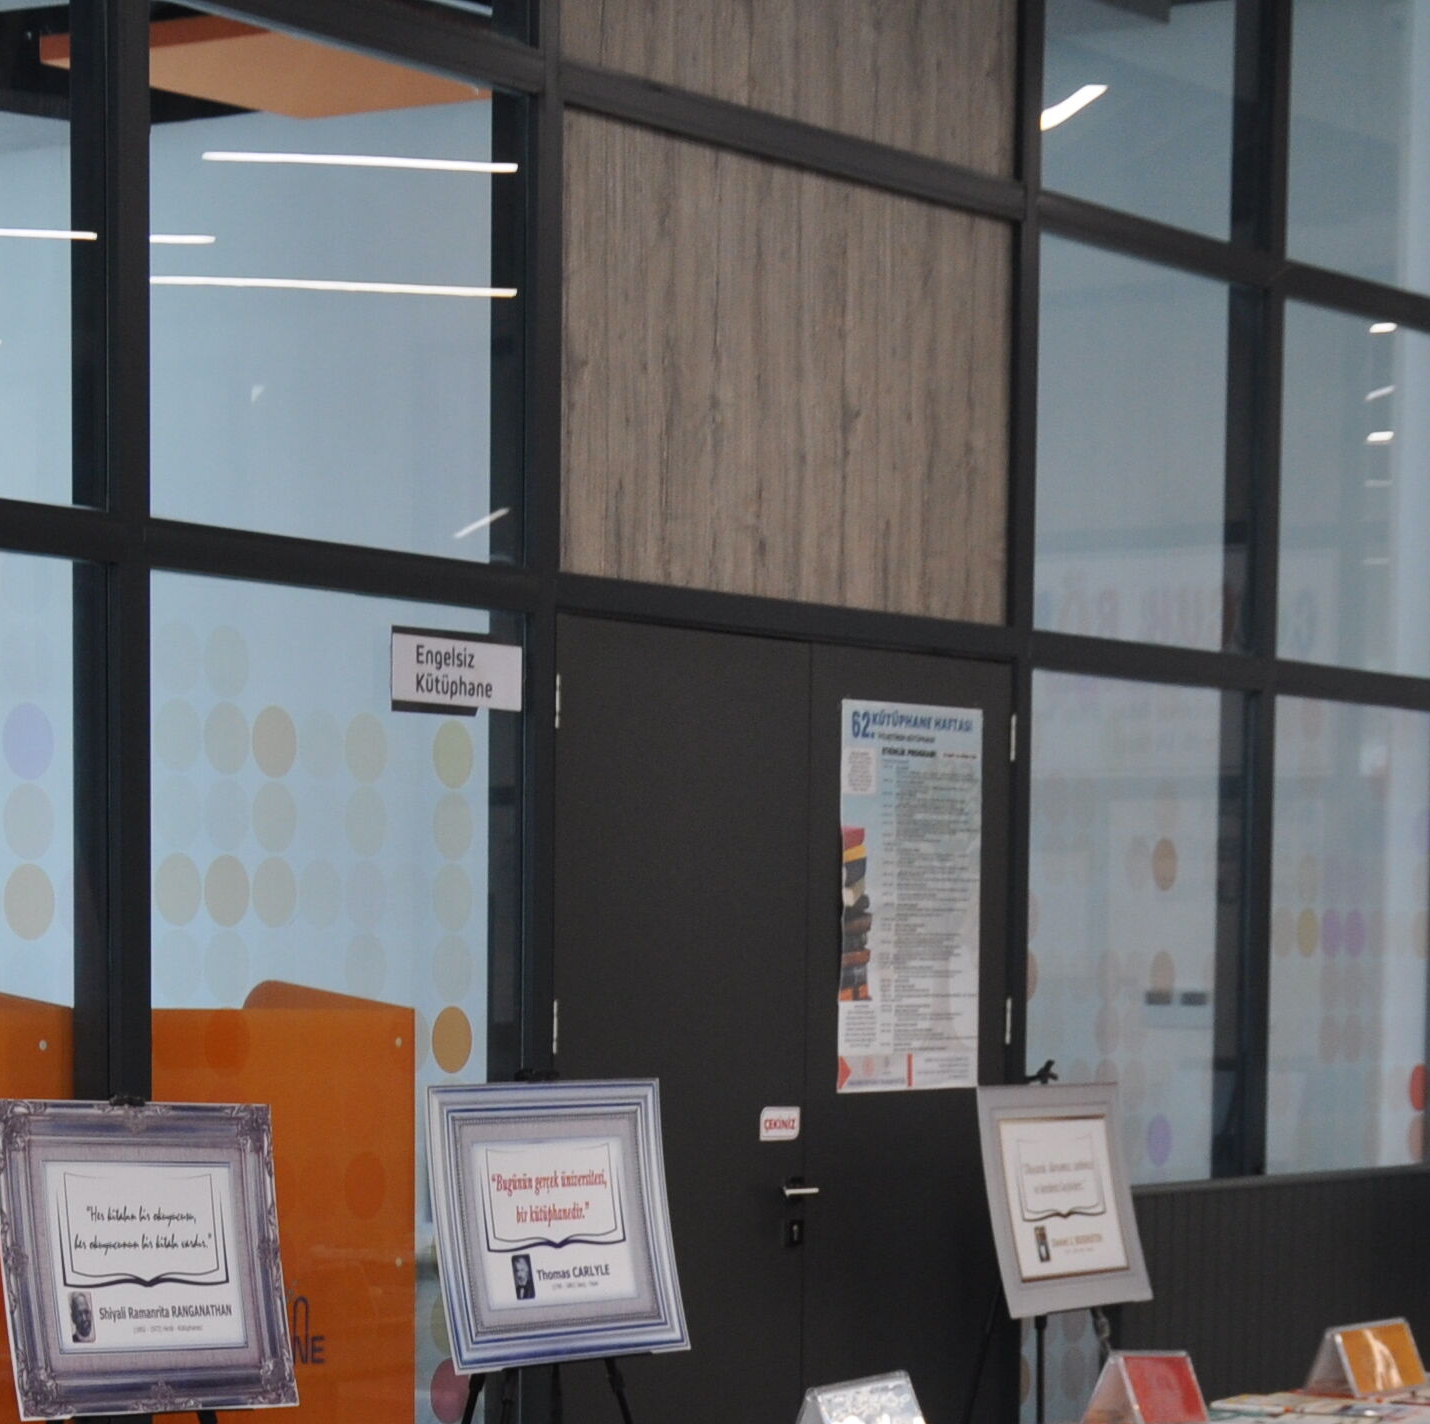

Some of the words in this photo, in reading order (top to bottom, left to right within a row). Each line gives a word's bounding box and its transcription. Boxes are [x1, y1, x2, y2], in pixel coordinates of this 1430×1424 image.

[416, 644, 475, 671] Engelsiz
[416, 673, 493, 701] Kütüphane
[851, 710, 875, 739] 62.
[139, 1205, 151, 1221] bir
[516, 1205, 528, 1224] bir
[74, 1233, 87, 1250] her
[141, 1233, 153, 1250] bir
[536, 1268, 571, 1281] Thomas
[572, 1264, 611, 1279] CARLYLE
[99, 1307, 127, 1323] Shiyali
[128, 1305, 170, 1320] Ramanrita
[171, 1304, 233, 1318] RANGANATHAN
